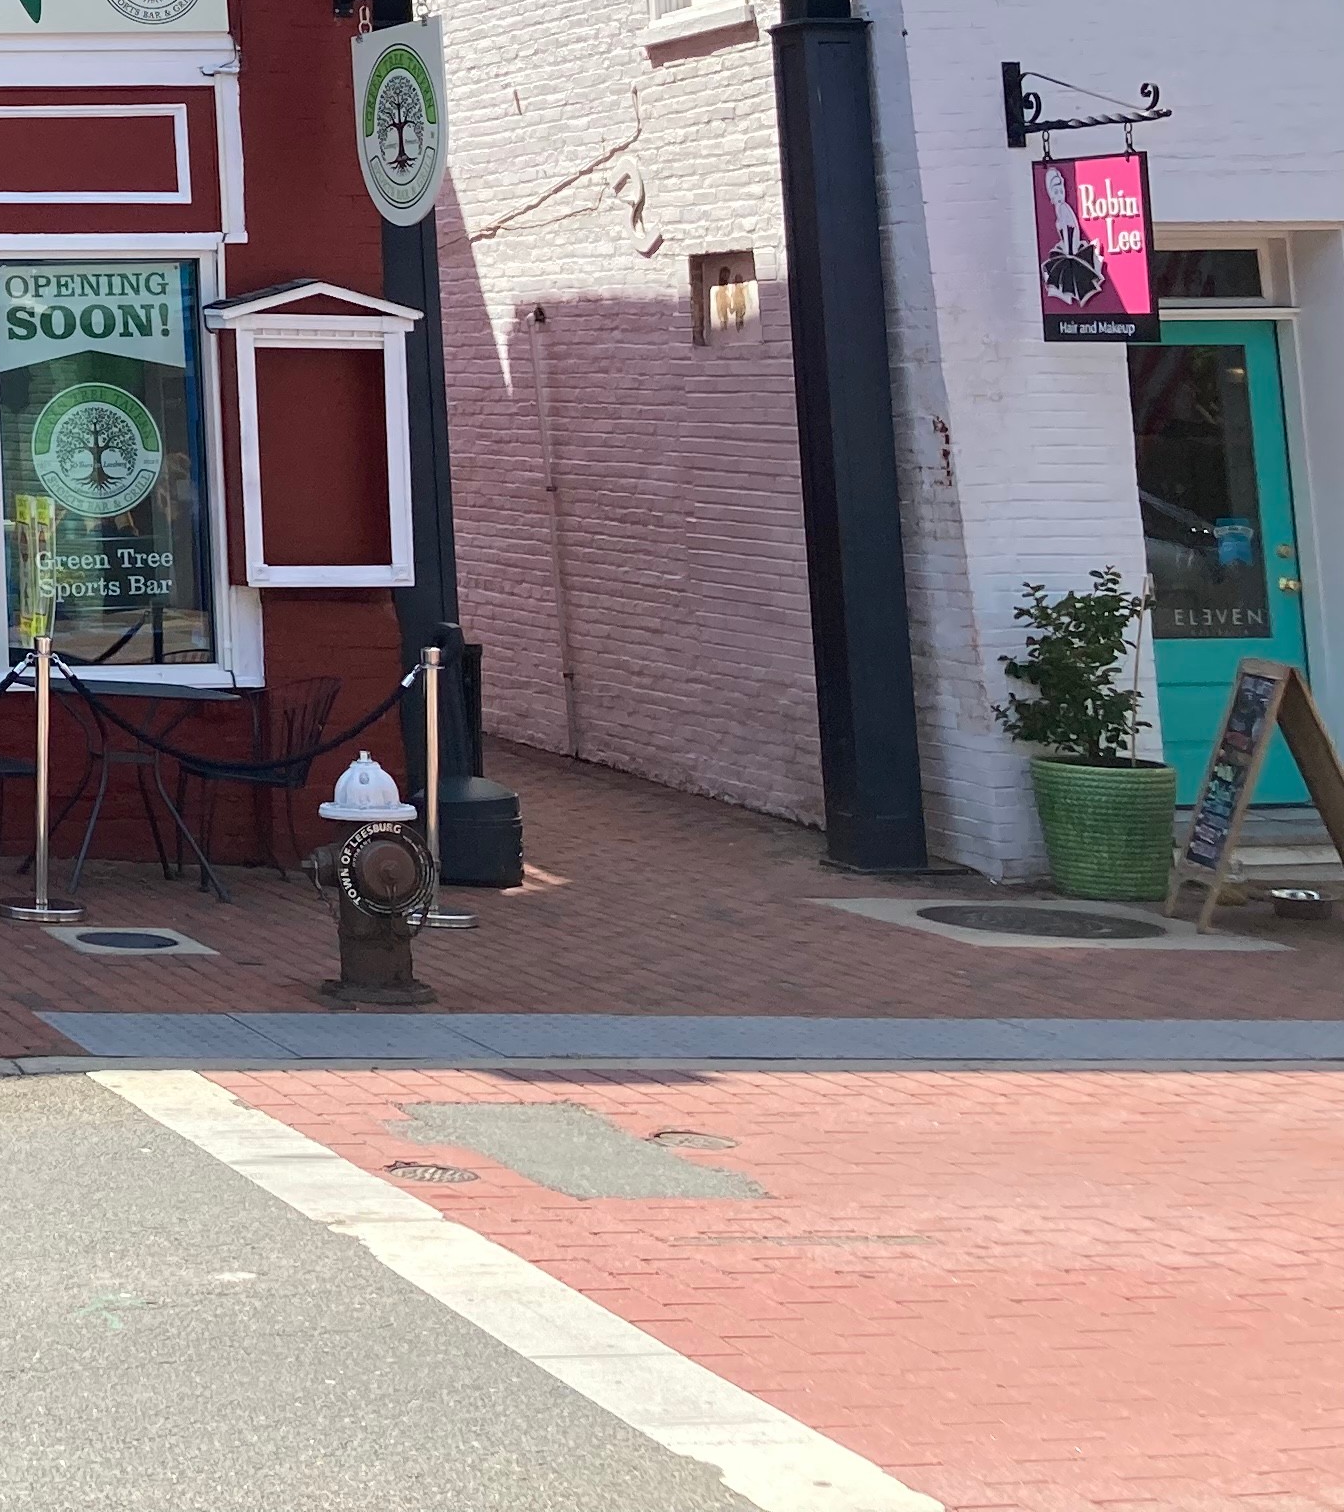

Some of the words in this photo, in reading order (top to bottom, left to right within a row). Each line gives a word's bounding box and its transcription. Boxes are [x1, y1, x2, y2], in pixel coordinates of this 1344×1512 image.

[142, 10, 161, 19] BAR
[162, 8, 171, 17] &
[406, 53, 434, 111] TAVERN
[1078, 178, 1140, 220] Robin
[1105, 217, 1142, 253] Lee
[4, 272, 169, 299] OPENING
[6, 303, 170, 340] SOON!
[1059, 321, 1077, 335] Hair
[1079, 322, 1097, 334] and
[1098, 321, 1136, 336] Makeup
[111, 392, 154, 440] TAVERN
[45, 474, 85, 509] SPORTS
[86, 499, 109, 510] BAR
[112, 498, 122, 508] &
[121, 471, 152, 504] GRILL
[36, 551, 110, 571] Green
[117, 549, 173, 568] Tree
[39, 578, 120, 603] Sports
[128, 575, 172, 595] Bar
[1174, 608, 1263, 626] ELEVEN
[349, 822, 402, 848] LEESBURG
[341, 848, 352, 865] OF
[340, 868, 361, 906] TOWN
